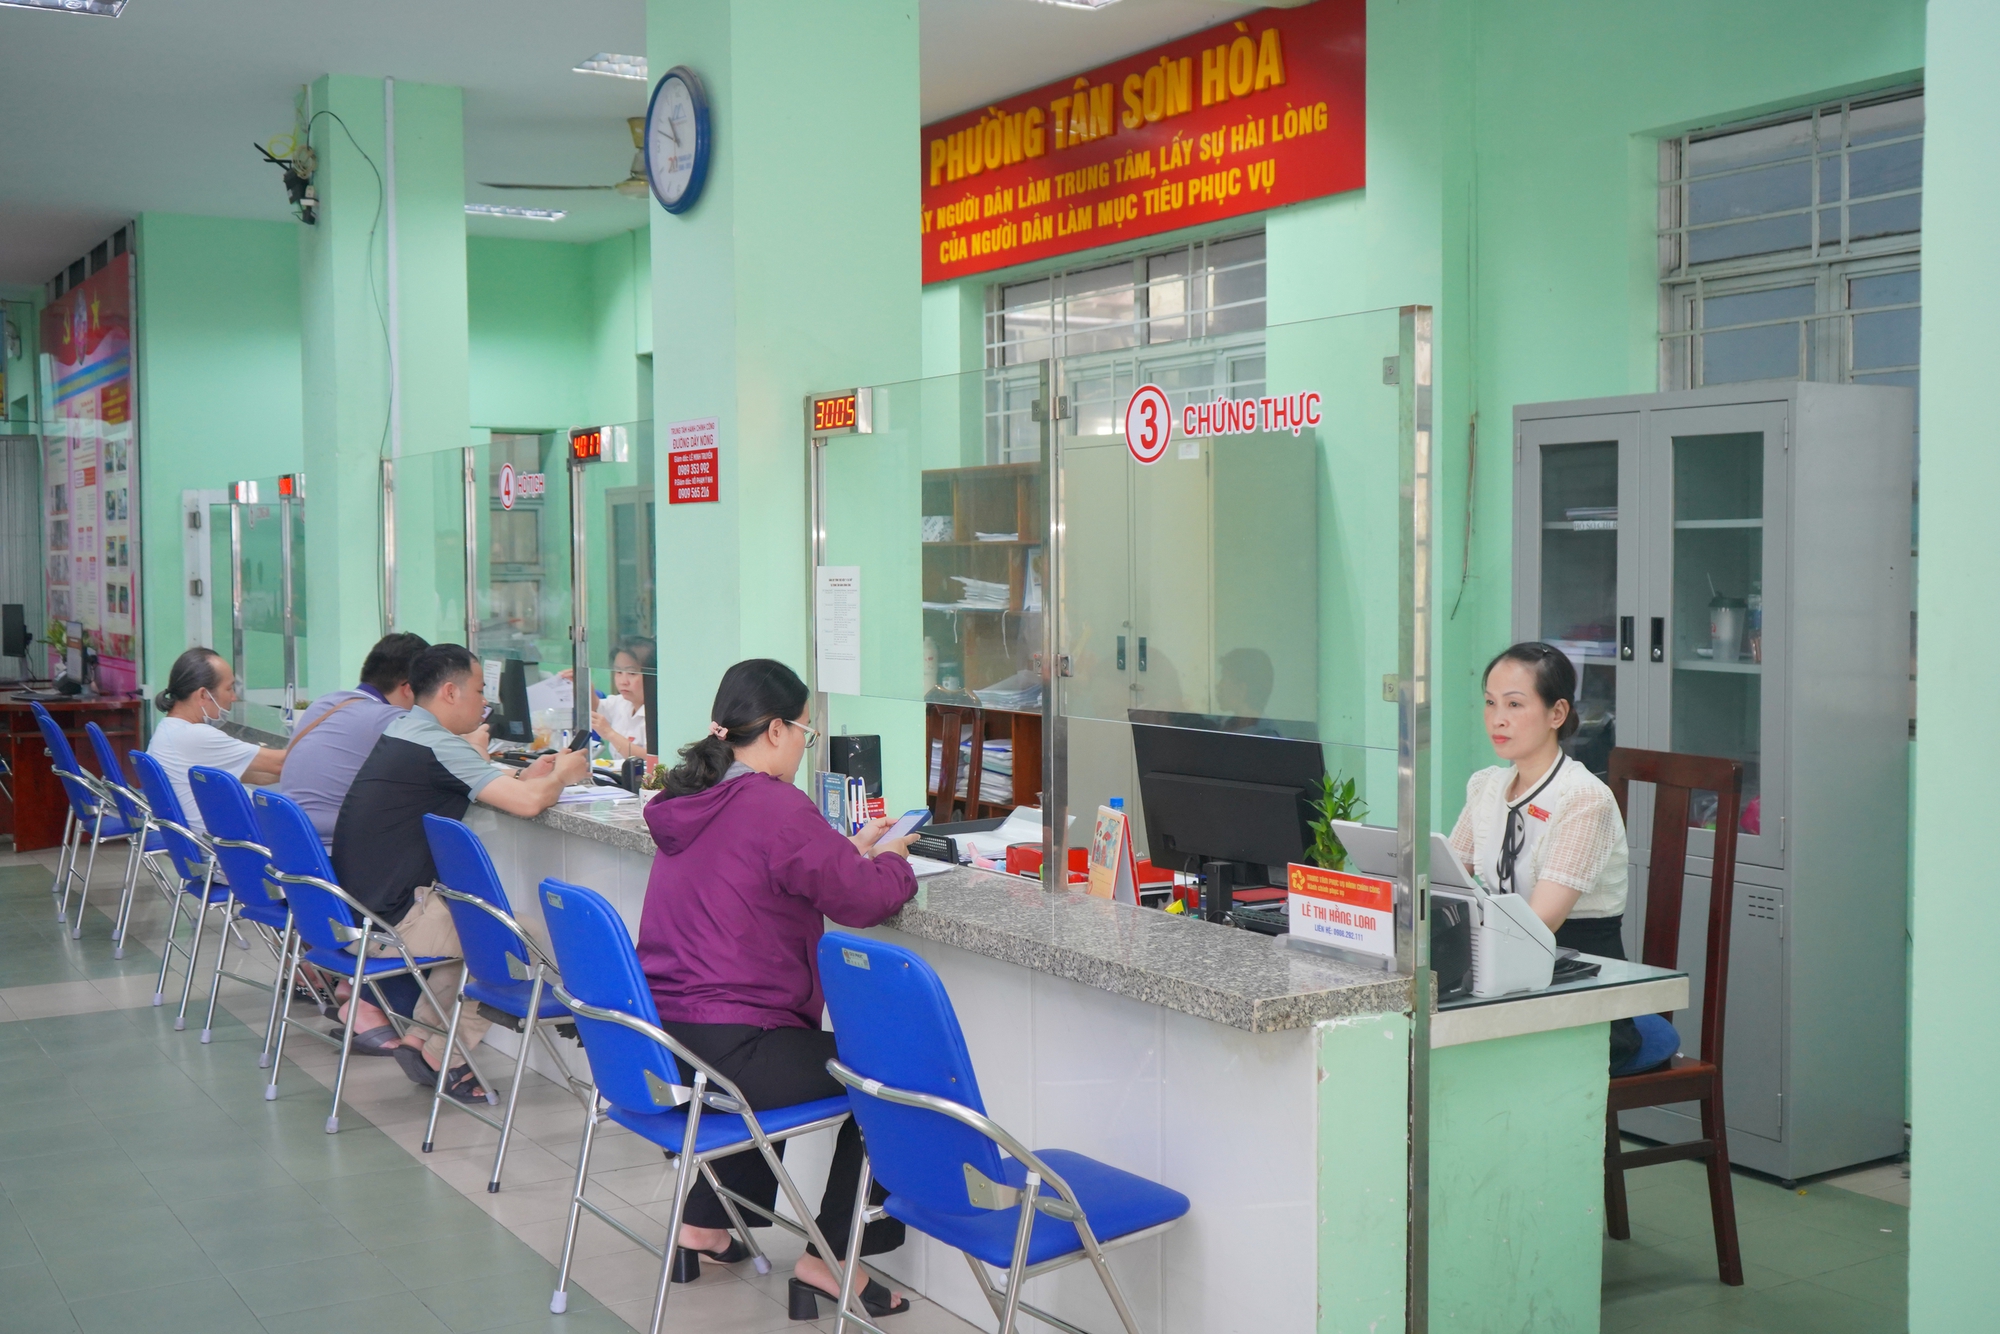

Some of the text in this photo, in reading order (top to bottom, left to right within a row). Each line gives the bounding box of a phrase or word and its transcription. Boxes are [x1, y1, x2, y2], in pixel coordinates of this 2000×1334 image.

[929, 21, 1286, 187] PHƯỜNG TÂN SƠN HÒA
[937, 192, 980, 230] NGƯỜI
[984, 185, 1014, 218] DÂN
[1018, 176, 1051, 209] LÀM
[1055, 162, 1109, 198] TRUNG
[1114, 149, 1156, 179] TÂM,
[1160, 130, 1194, 172] LẤY
[1199, 125, 1227, 165] SỰ
[1231, 114, 1265, 153] HÀI
[1272, 102, 1328, 143] LÒNG
[940, 159, 1275, 264] CỦA NGƯỜI DÂN LÀM MỤC TIÊU PHỤC VỤ
[815, 397, 855, 429] 3005
[1140, 392, 1321, 450] 3 CHỨNG THỰC
[673, 436, 689, 449] ĐƯỜNG
[690, 434, 699, 447] DÂY
[504, 471, 511, 501] 4
[1302, 901, 1376, 931] LÊ THỊ HẰNG LOAN
[1314, 923, 1324, 932] LIÊN
